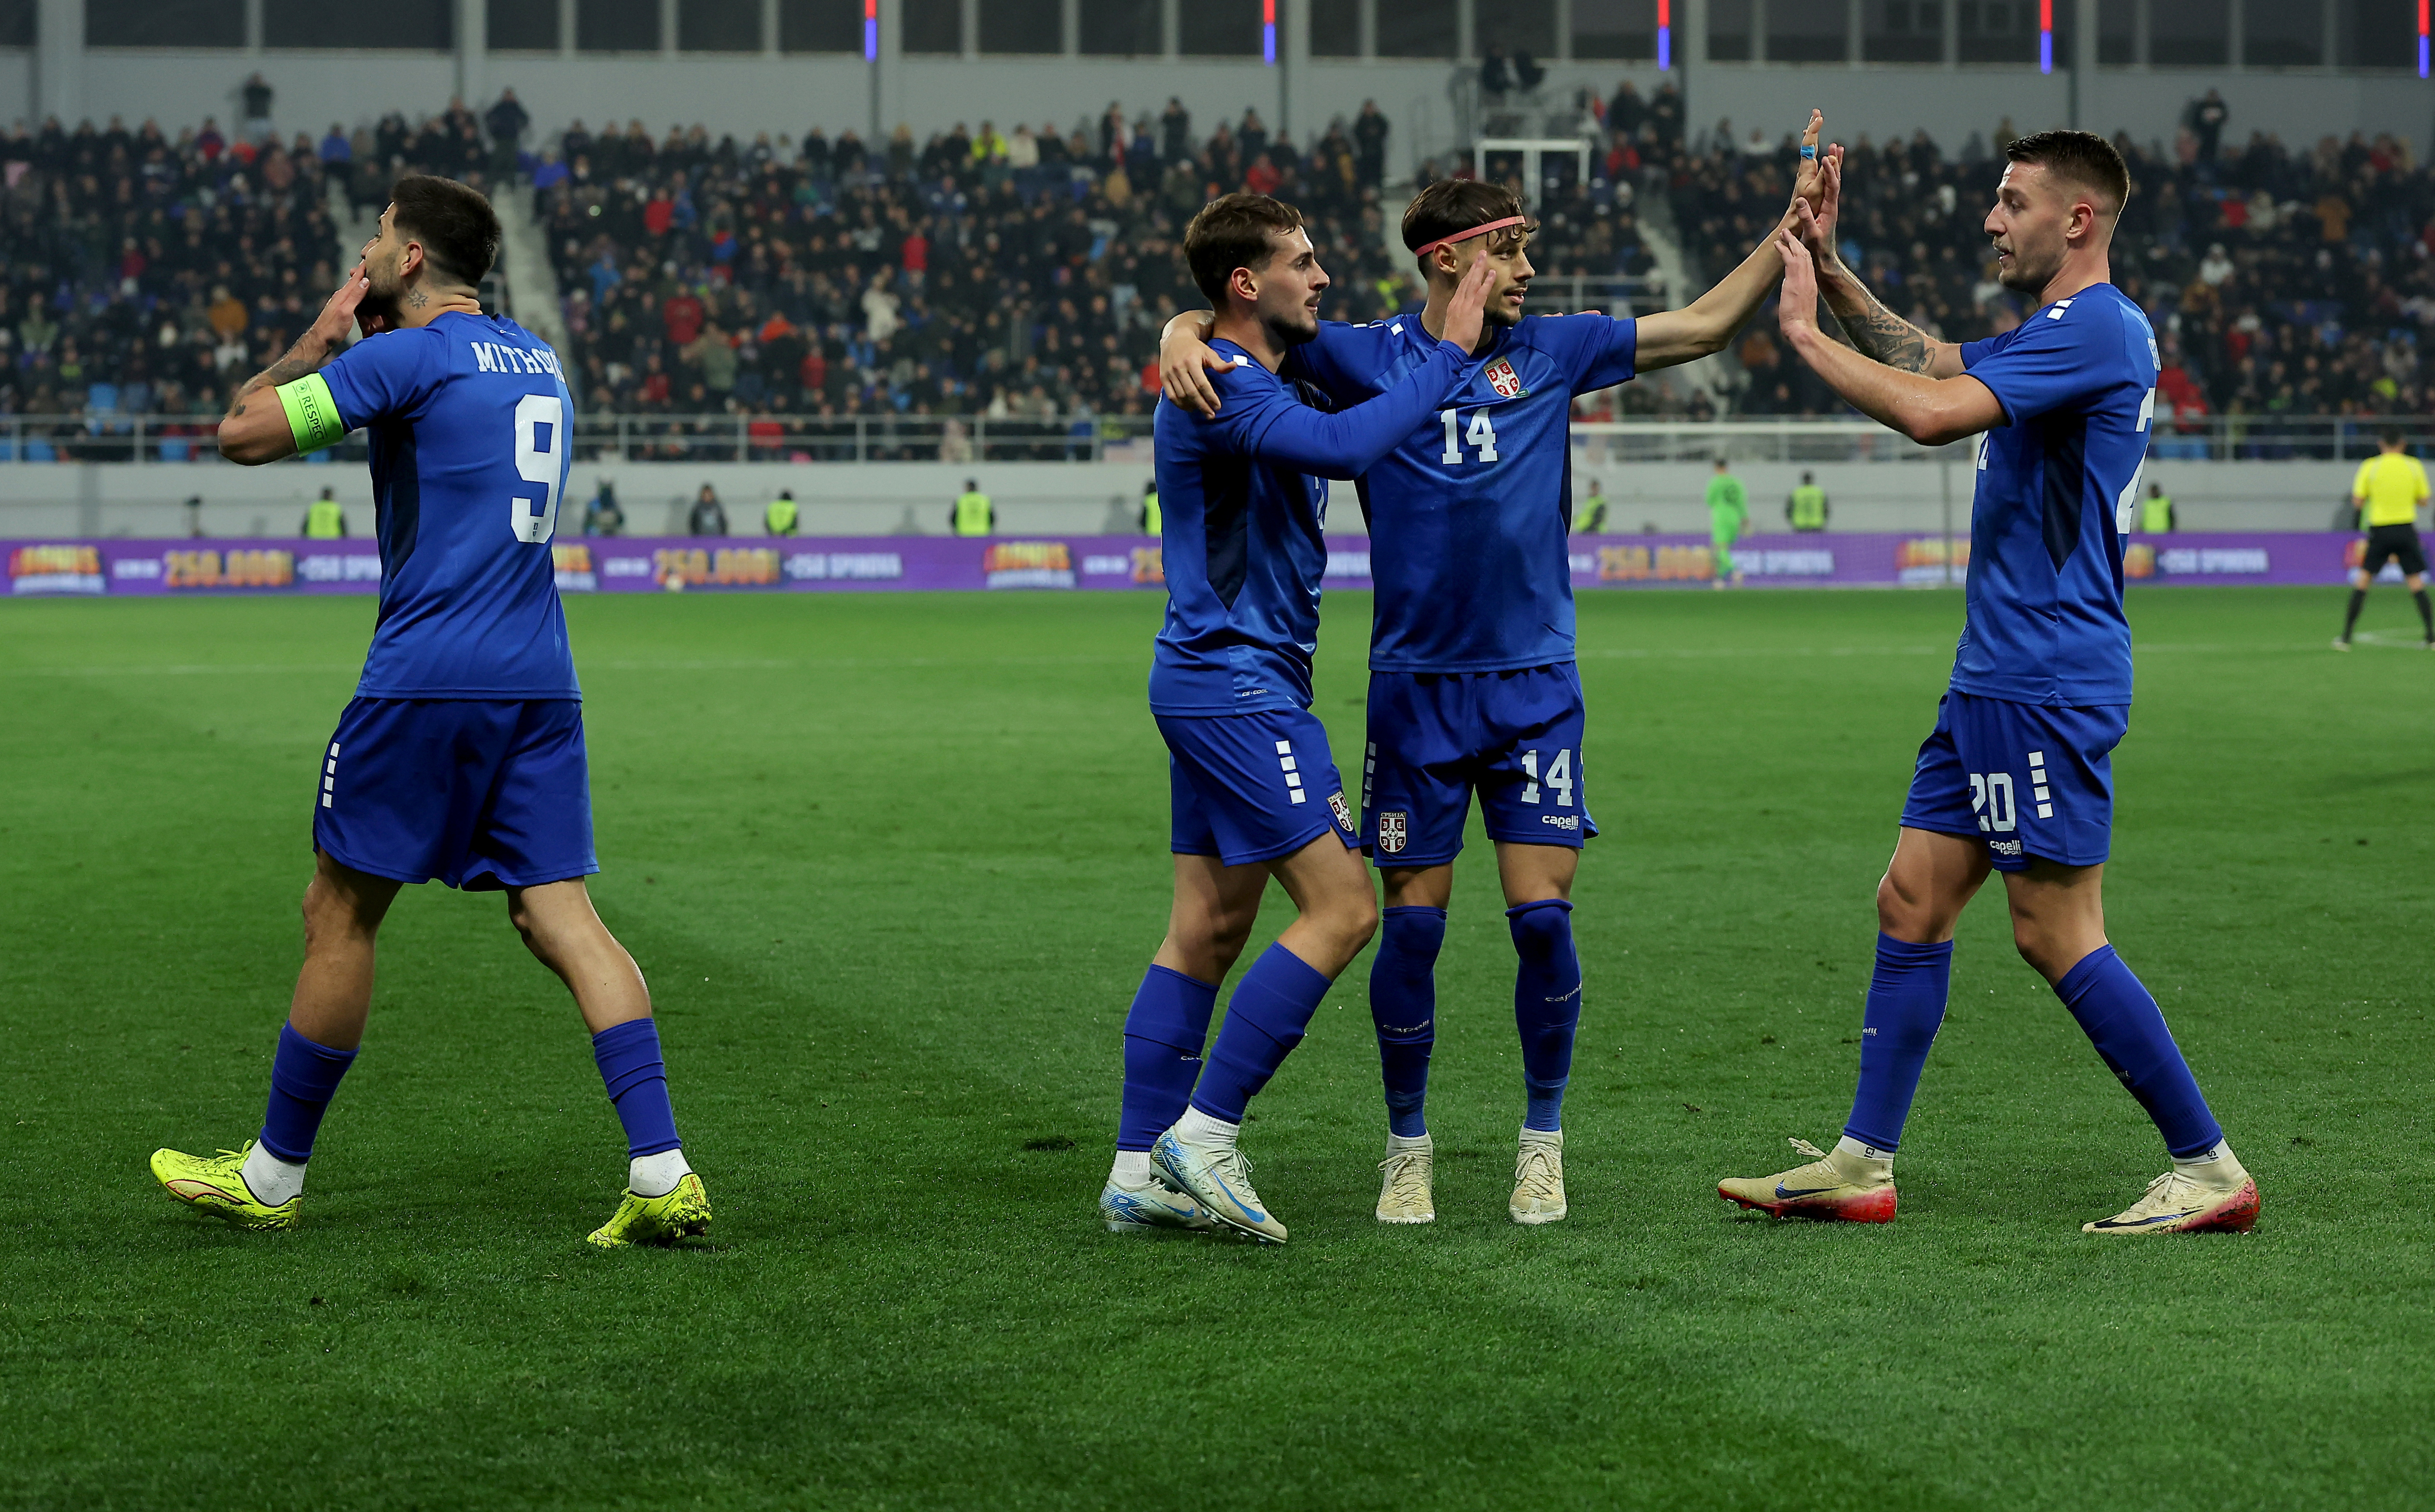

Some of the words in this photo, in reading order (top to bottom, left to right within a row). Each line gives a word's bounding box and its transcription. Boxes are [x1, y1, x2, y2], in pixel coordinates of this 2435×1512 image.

[1441, 407, 1498, 464] 14
[511, 394, 563, 544] 9
[1521, 749, 1573, 806] 14
[1542, 815, 1579, 827] capelli
[1990, 840, 2021, 853] capelli
